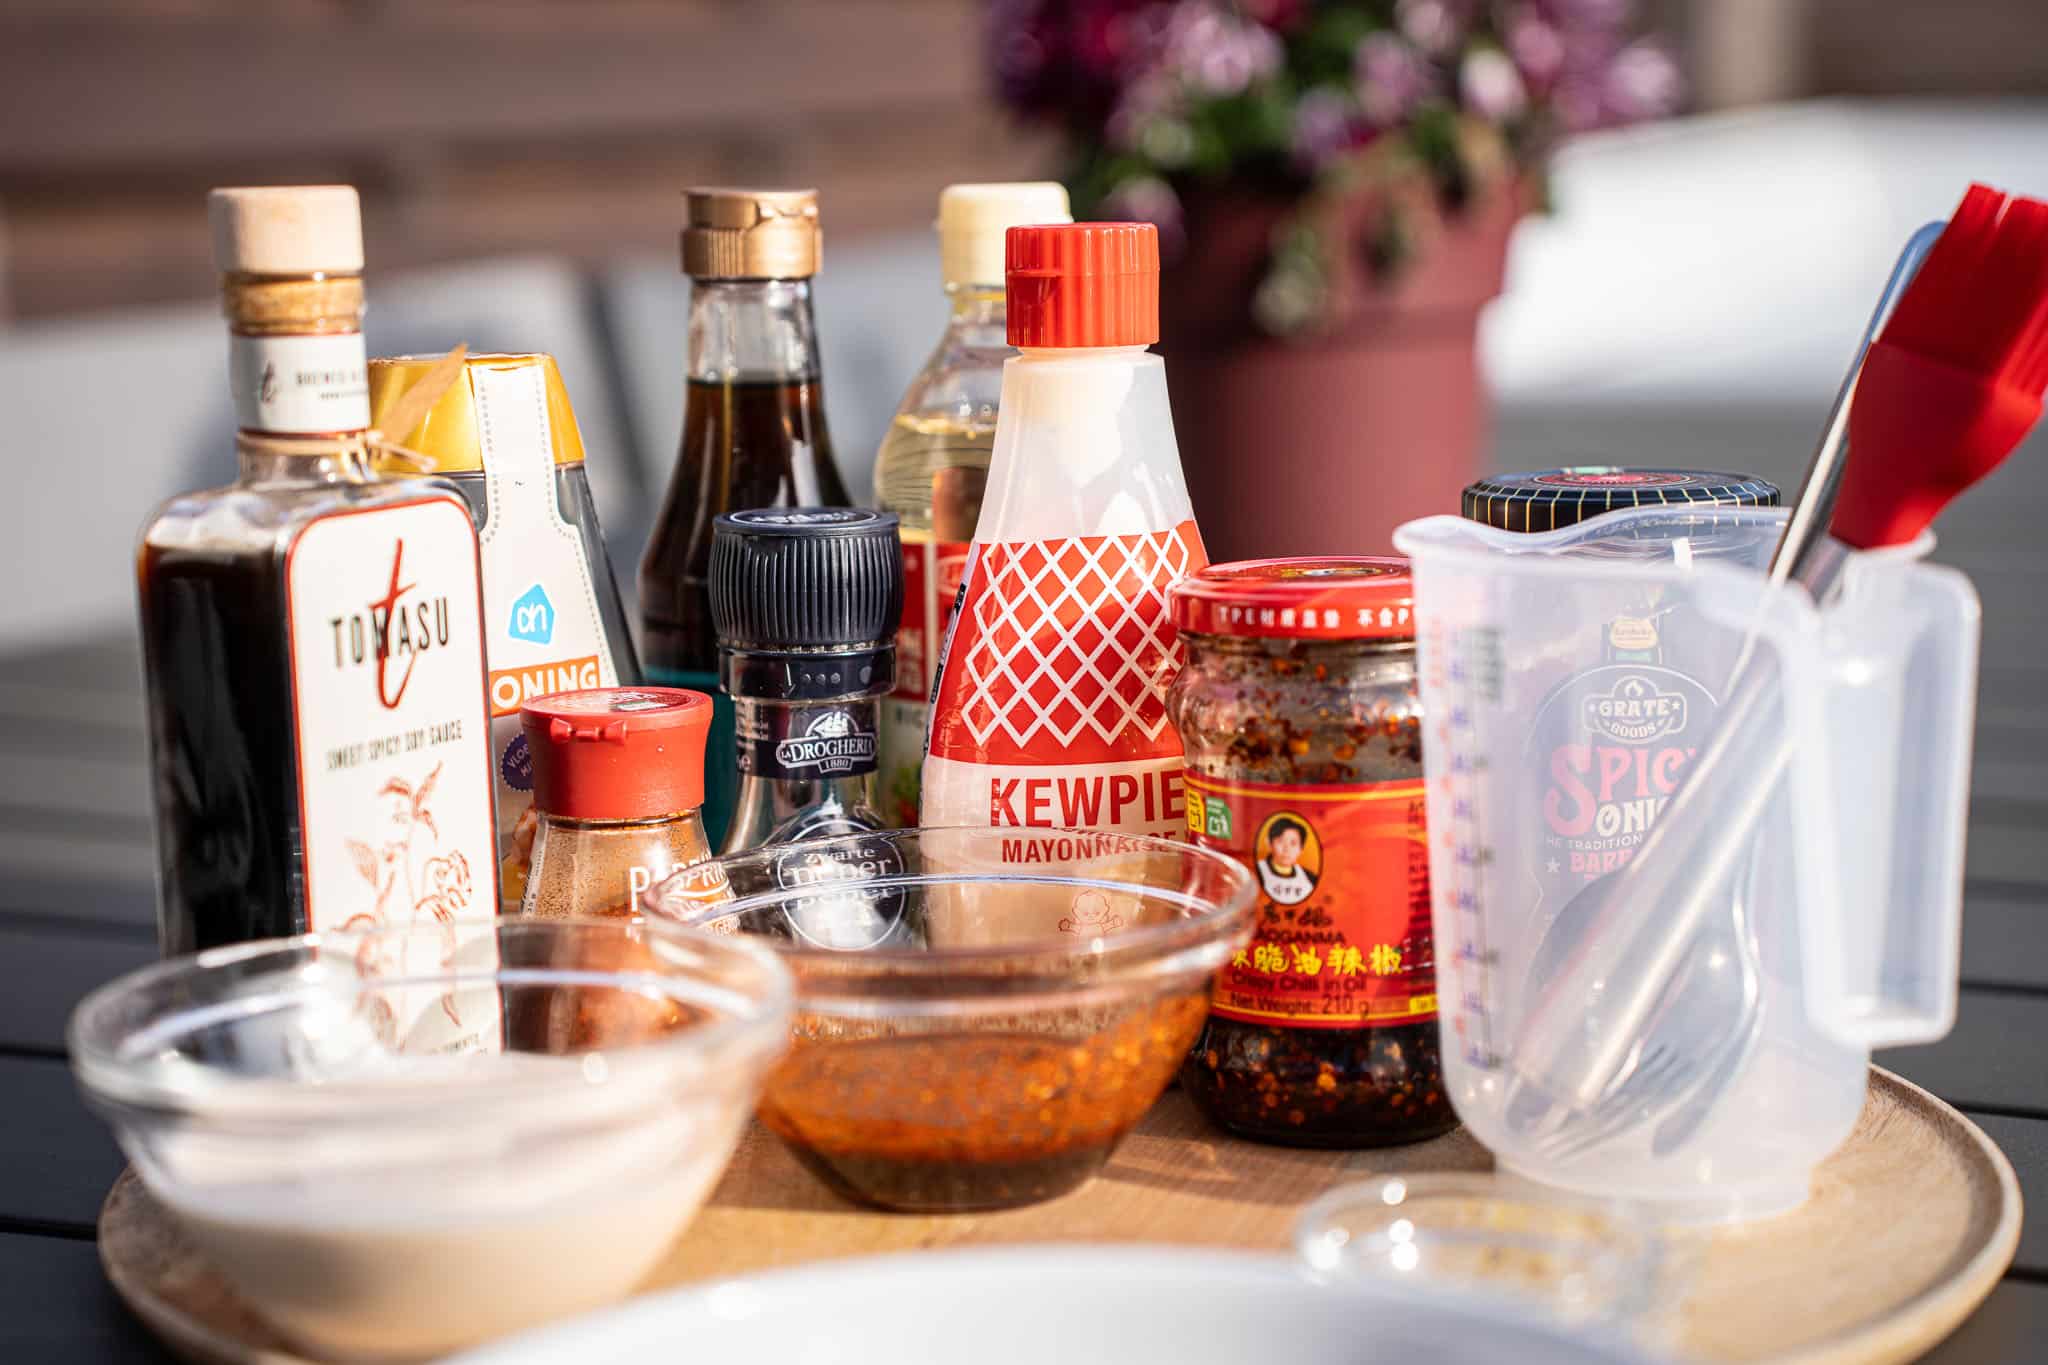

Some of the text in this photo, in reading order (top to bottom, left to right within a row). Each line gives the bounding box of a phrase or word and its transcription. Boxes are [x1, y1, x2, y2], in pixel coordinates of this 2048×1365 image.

[331, 597, 449, 667] TOWASU
[1599, 699, 1669, 718] GRATE
[1609, 722, 1657, 738] GOODS
[990, 769, 1186, 827] KEWPIE
[1543, 744, 1697, 838] SPIC
[1324, 994, 1354, 1015] 210
